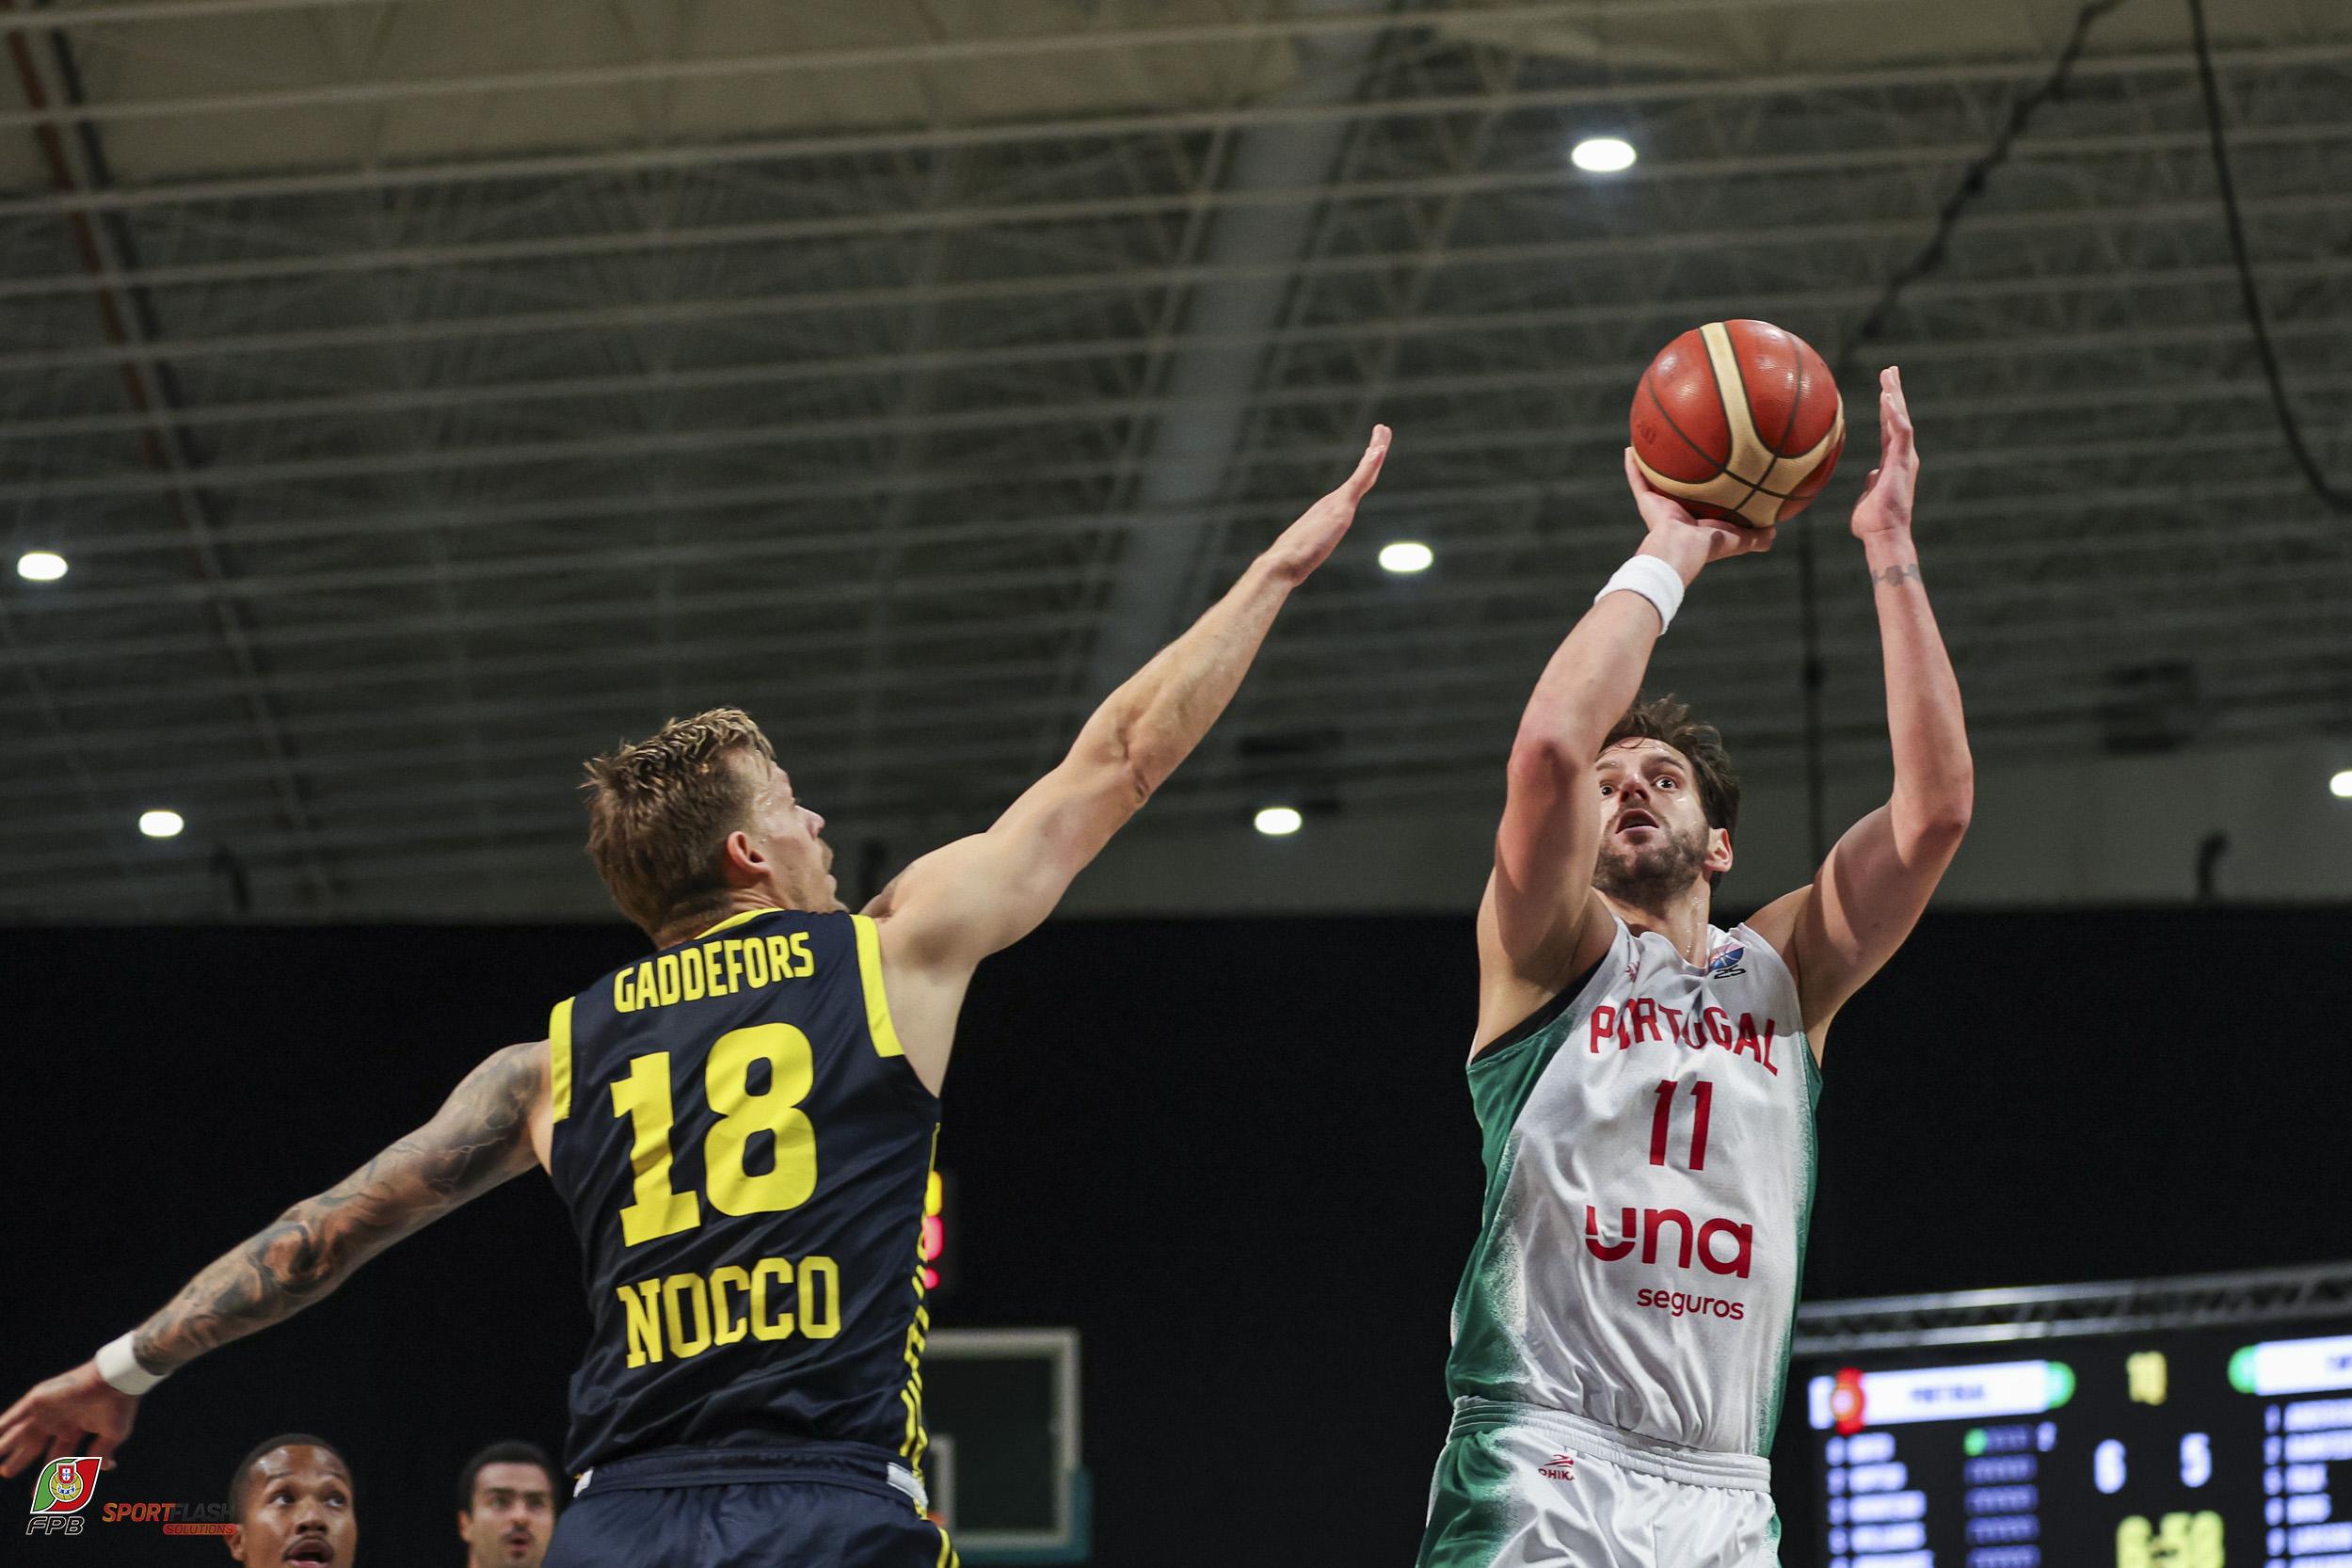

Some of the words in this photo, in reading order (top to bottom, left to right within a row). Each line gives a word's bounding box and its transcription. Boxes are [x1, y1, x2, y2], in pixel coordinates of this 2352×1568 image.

[614, 931, 815, 1014] GADDEFORS
[1590, 997, 1779, 1077] PORTUGAL
[610, 1022, 818, 1248] 18
[1649, 1079, 1714, 1172] 11
[1585, 1204, 1753, 1279] una
[616, 1256, 841, 1369] NOCCO
[1637, 1288, 1745, 1320] seguros
